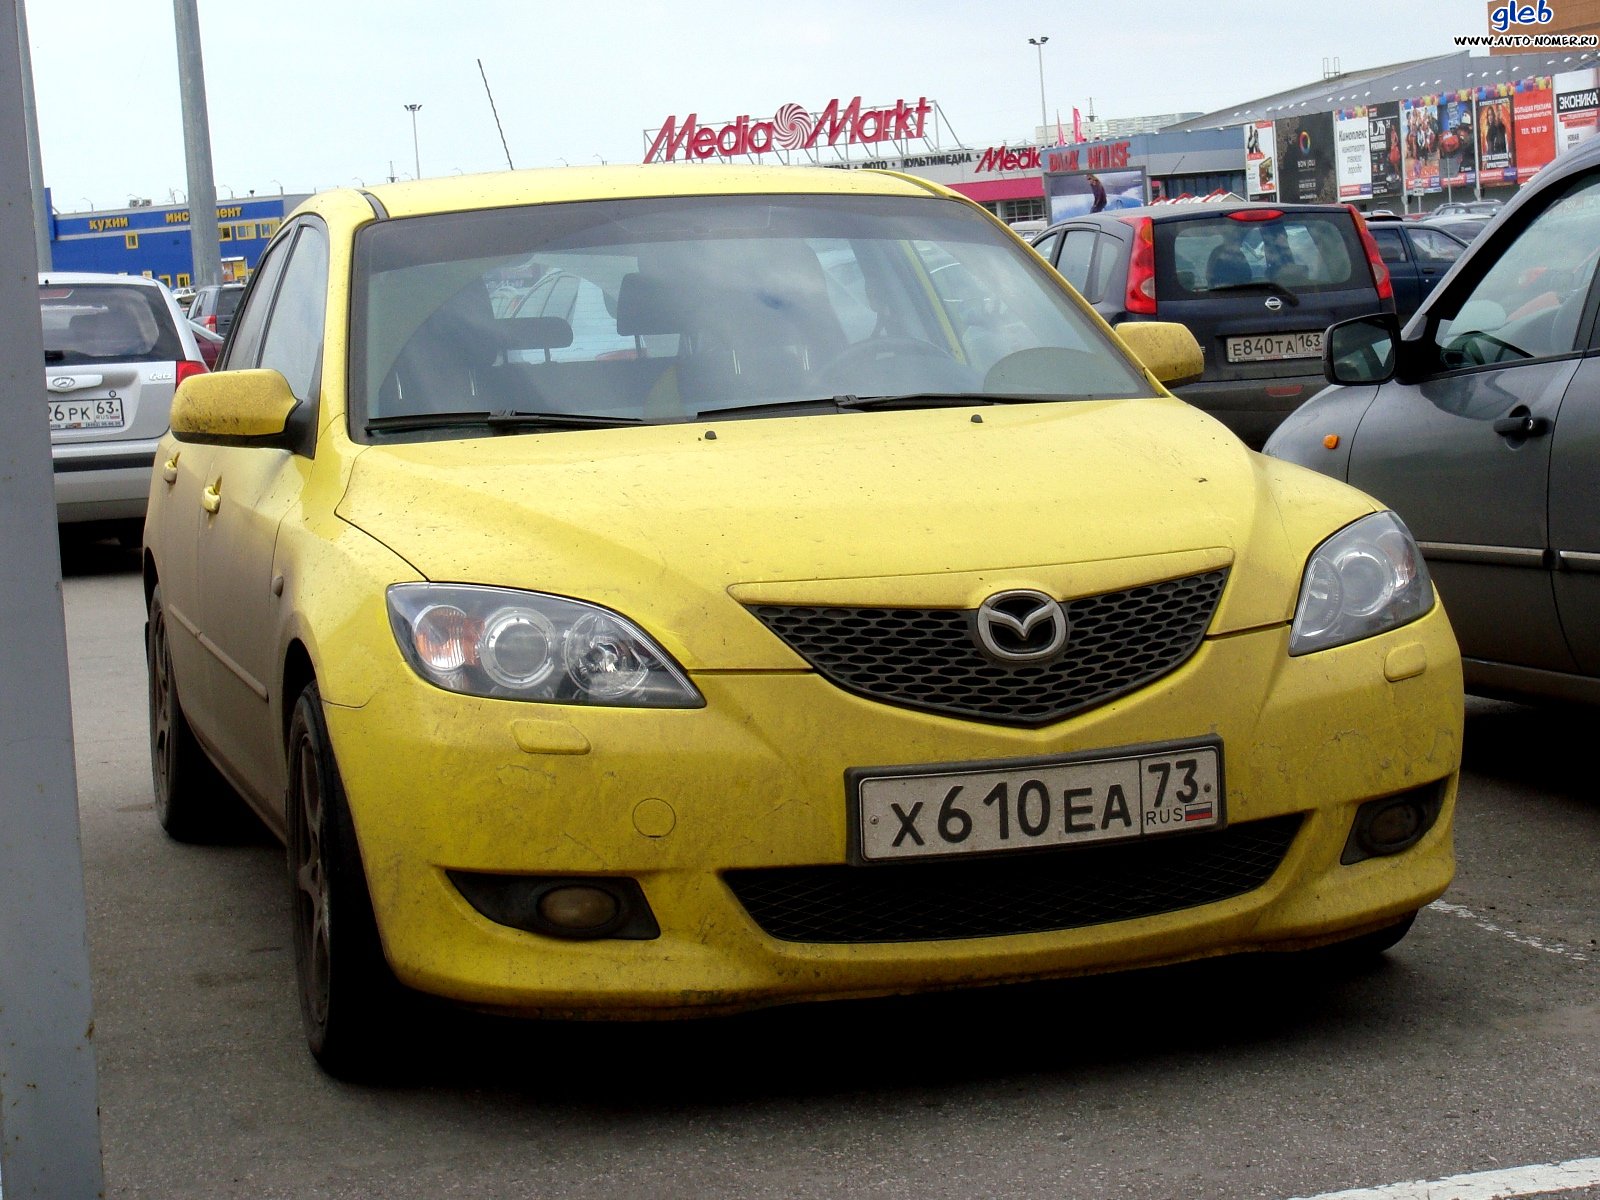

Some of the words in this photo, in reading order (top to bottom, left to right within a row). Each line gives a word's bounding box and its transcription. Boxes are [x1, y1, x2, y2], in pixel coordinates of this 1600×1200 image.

[1559, 92, 1598, 110] ЭКОНИКА
[643, 113, 773, 164] Media
[804, 96, 931, 149] Markt
[862, 160, 888, 170] ФОТО
[89, 216, 128, 231] кухни
[1298, 334, 1320, 348] 163
[96, 401, 114, 414] 63
[1148, 759, 1198, 808] 73
[1146, 807, 1183, 826] RUS
